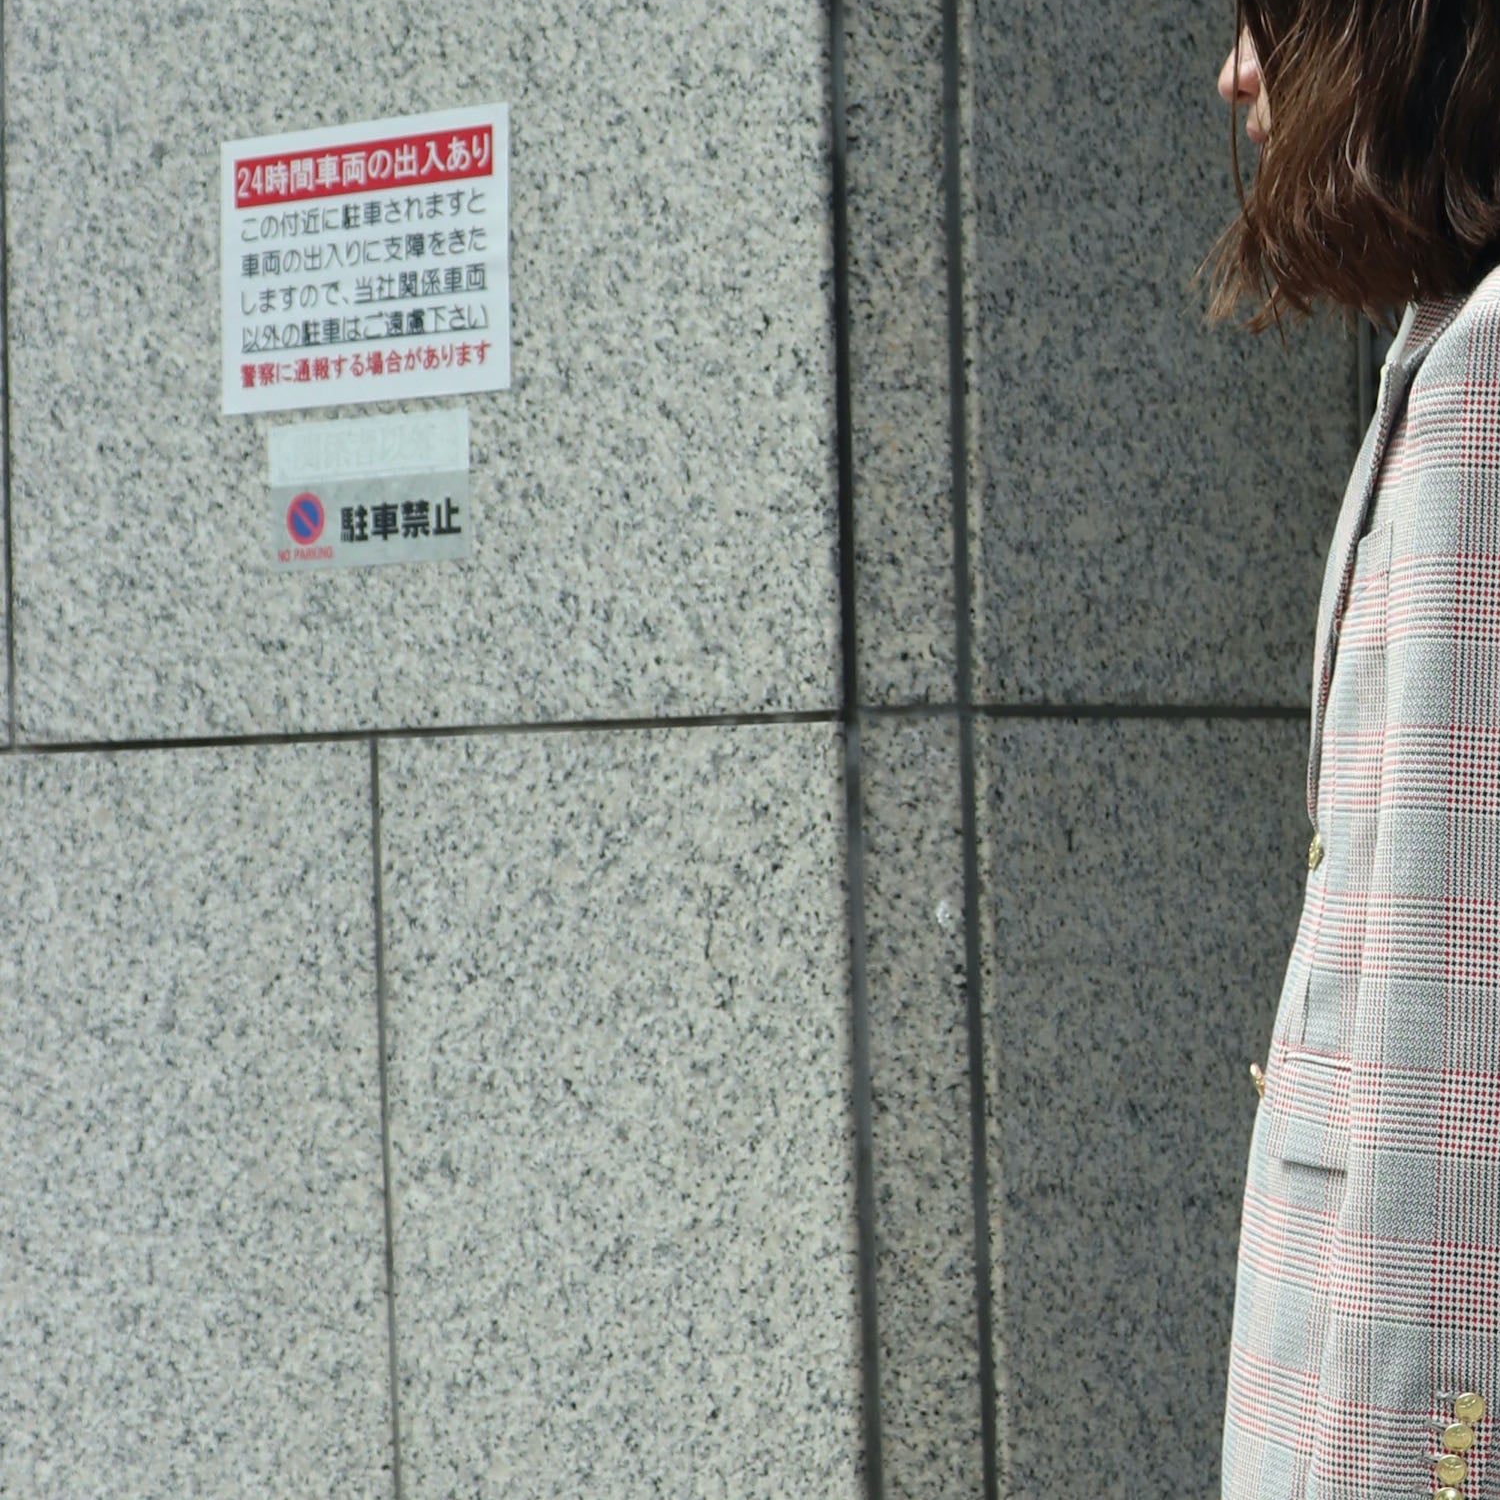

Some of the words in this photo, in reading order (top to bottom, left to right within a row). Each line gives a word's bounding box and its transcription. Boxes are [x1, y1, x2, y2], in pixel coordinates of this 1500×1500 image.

[237, 133, 490, 198] 24時間車両の出入あり
[241, 188, 486, 242] この付近に駐車されますと
[241, 227, 487, 278] 車両の出入りに支障をきた
[241, 262, 486, 315] しますので、当社関係車両
[241, 304, 488, 351] 以外の駐車はご遠慮下さい
[240, 340, 491, 388] 警察に通報する場合があります
[340, 497, 462, 542] 駐車禁止
[277, 548, 290, 563] NO
